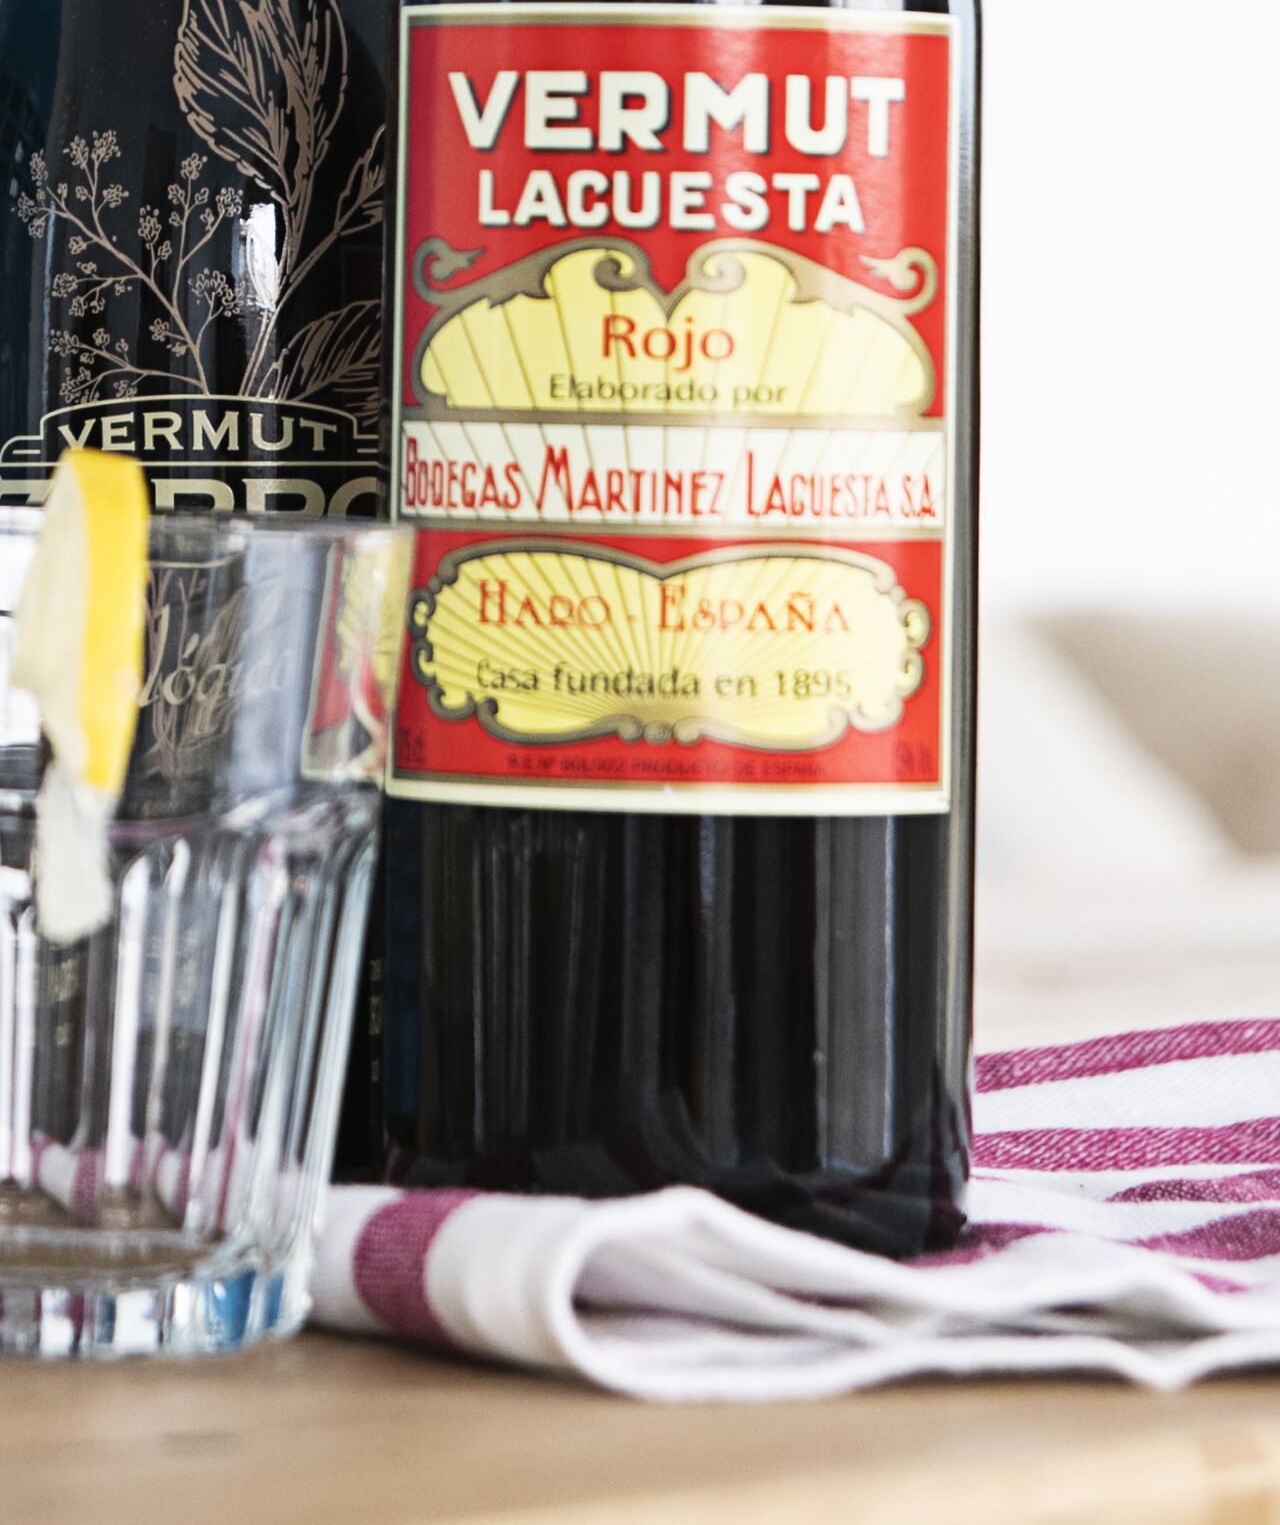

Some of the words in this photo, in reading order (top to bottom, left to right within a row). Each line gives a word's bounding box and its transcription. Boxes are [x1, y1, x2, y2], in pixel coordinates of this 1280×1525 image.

[449, 71, 905, 157] VERMUT
[478, 169, 866, 233] LACUESTA
[600, 315, 735, 370] Rojo
[549, 375, 718, 403] Elaborado
[732, 383, 787, 409] por
[58, 410, 337, 452] VERMUT
[405, 437, 521, 509] BODEGAS
[537, 445, 725, 516] MARTINEZ
[746, 449, 893, 517] LACUESTA
[657, 582, 852, 634] ESPAÑA
[477, 659, 539, 691] Casa
[554, 661, 701, 697] fundada
[714, 675, 757, 697] en
[776, 669, 853, 701] 1895
